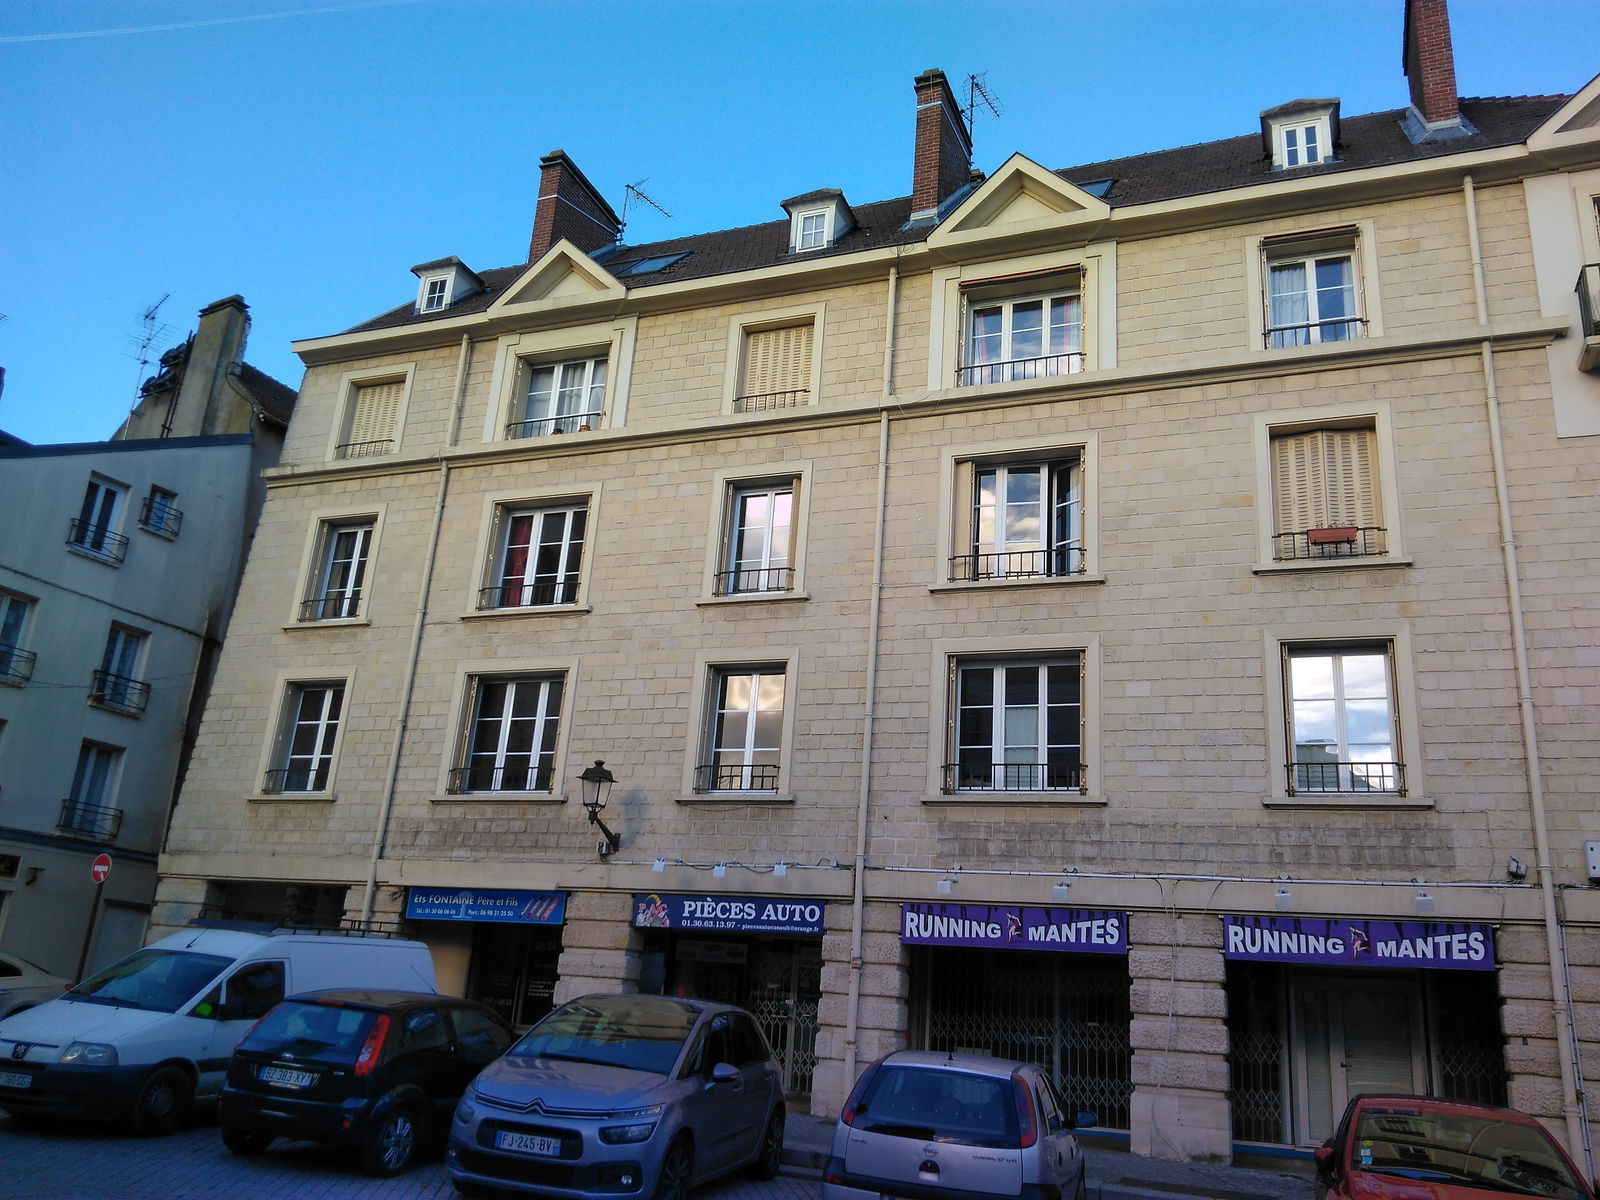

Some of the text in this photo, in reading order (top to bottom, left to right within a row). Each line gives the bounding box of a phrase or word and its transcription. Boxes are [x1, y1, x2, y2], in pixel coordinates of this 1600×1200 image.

[429, 895, 474, 905] FONTAINE
[477, 896, 494, 906] Père
[496, 898, 504, 906] et
[505, 896, 518, 907] Fils
[682, 896, 821, 922] PIÈCES AUTO
[905, 911, 1120, 945] RUNNING MANTES
[1228, 924, 1486, 961] RUNNING MANTES
